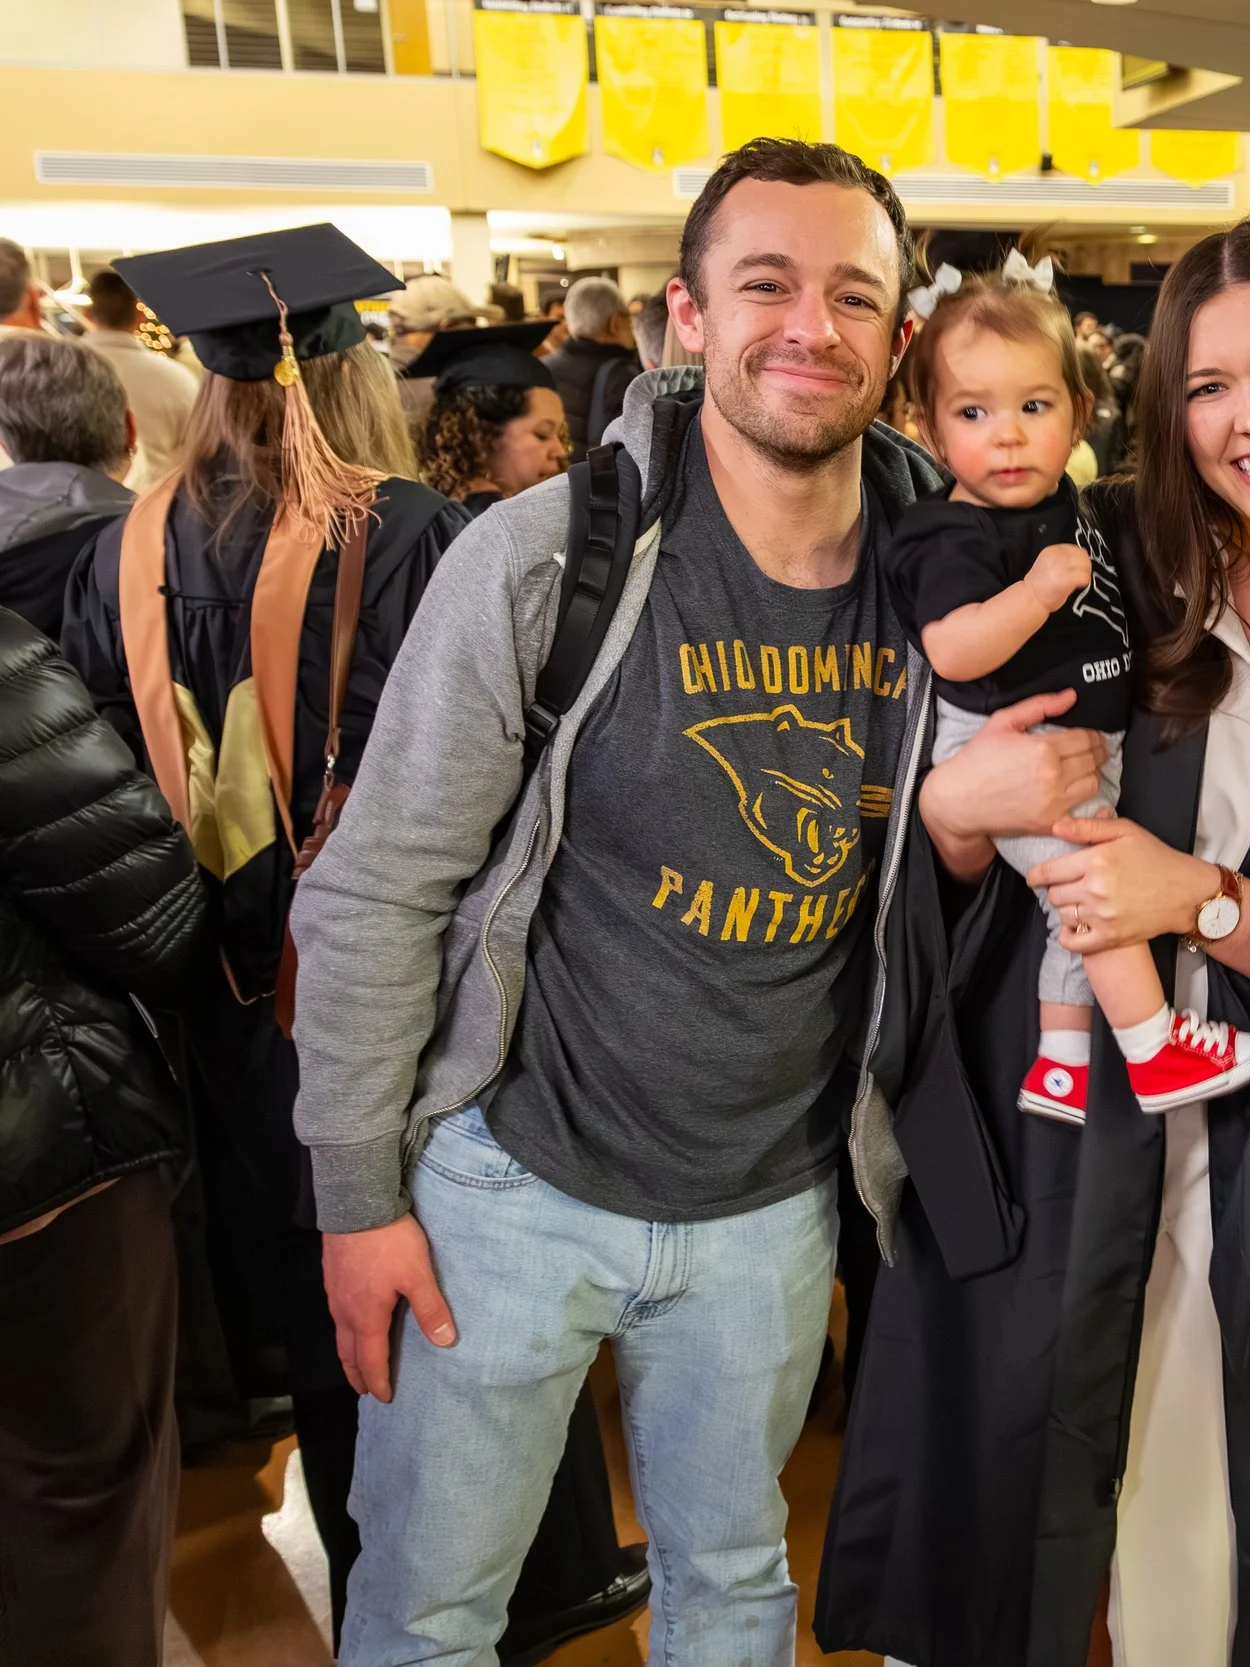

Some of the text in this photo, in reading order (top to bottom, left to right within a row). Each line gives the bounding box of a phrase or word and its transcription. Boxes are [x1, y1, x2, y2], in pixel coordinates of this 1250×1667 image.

[680, 639, 756, 694] OHIO
[1082, 657, 1121, 683] OHIO
[652, 866, 867, 944] PANTHE
